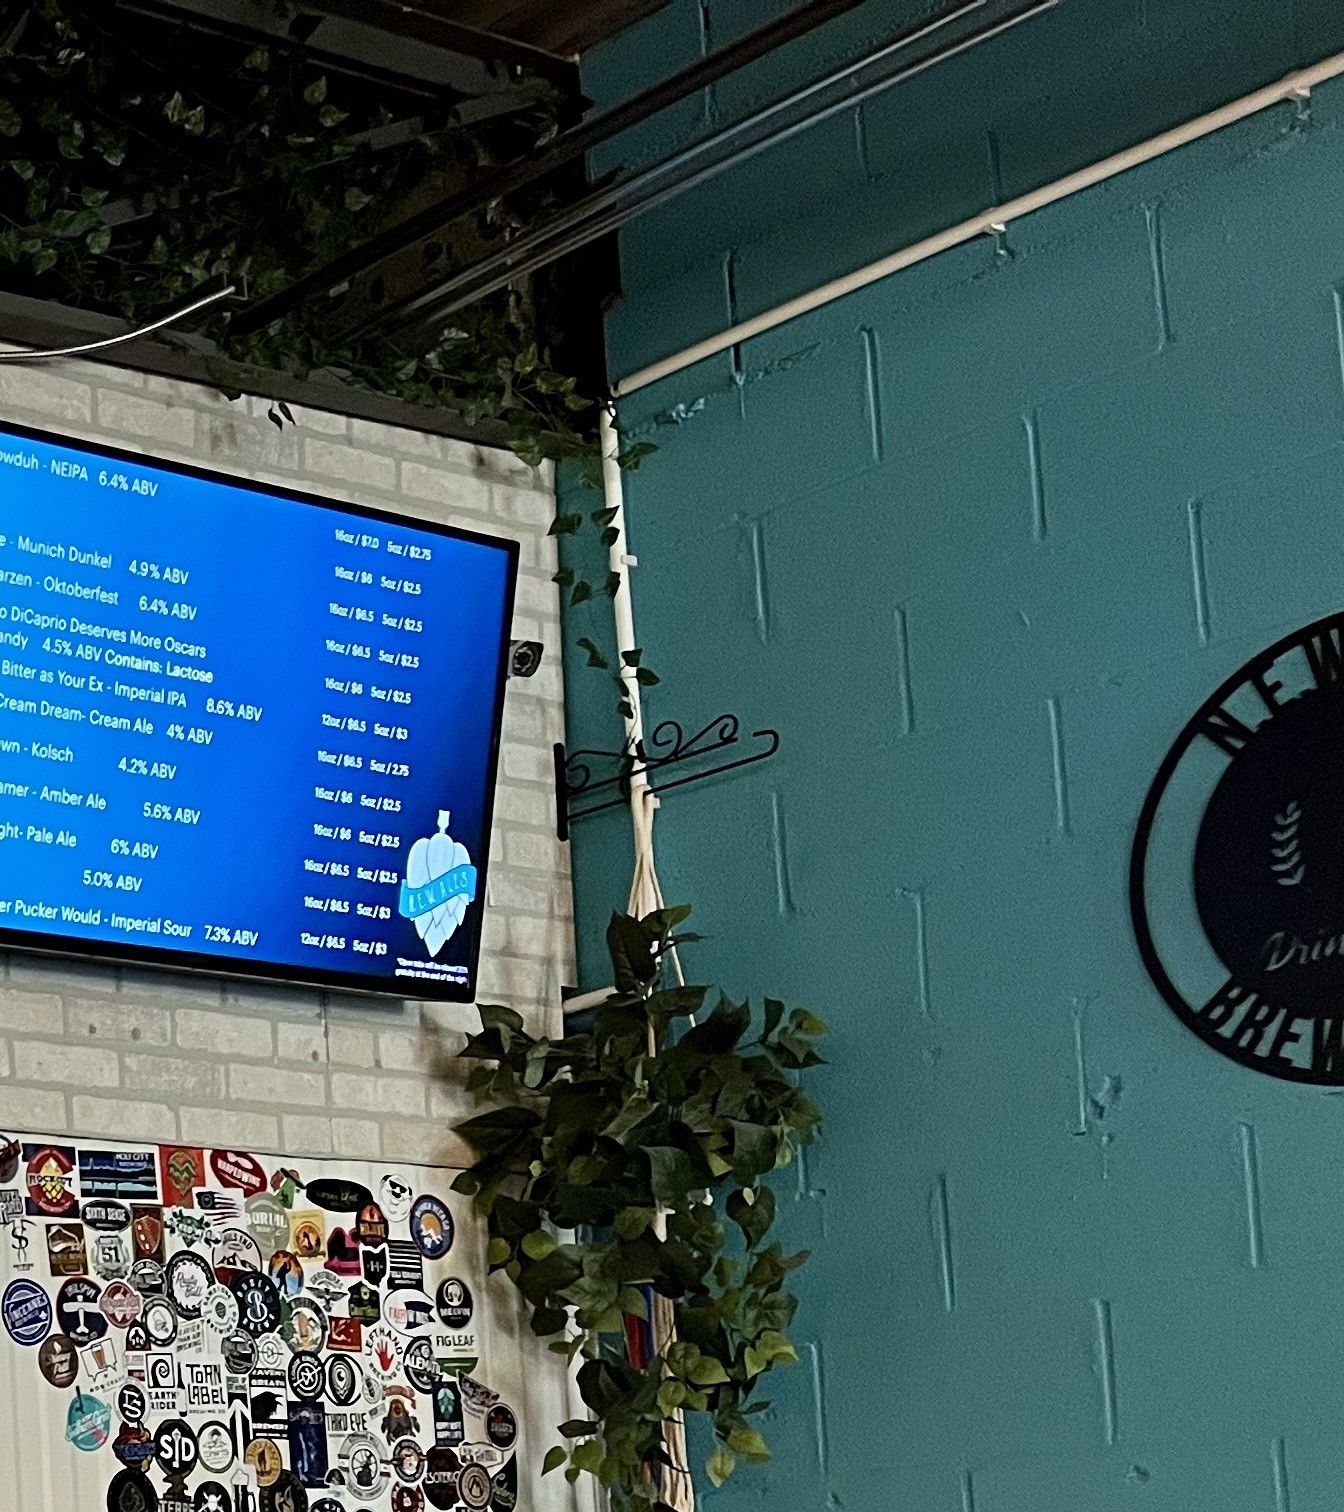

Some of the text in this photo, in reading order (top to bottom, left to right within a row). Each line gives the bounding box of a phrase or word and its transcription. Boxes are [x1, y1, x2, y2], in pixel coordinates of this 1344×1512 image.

[51, 460, 89, 481] NEIPA
[99, 471, 128, 490] 6.4%
[132, 478, 158, 497] ABV
[17, 536, 65, 559] Munich
[69, 546, 112, 569] Dunkel
[43, 576, 119, 605] Oktoberfest
[11, 604, 67, 630] DiCaprio
[70, 619, 127, 643] Deserves
[130, 630, 161, 650] More
[164, 637, 207, 658] Oscars
[1196, 622, 1344, 757] NEW
[89, 711, 130, 731] Cream
[133, 717, 154, 735] Ale
[31, 742, 73, 763] Kolsch
[26, 826, 53, 843] Pale
[56, 831, 77, 847] Ale
[15, 900, 58, 920] Pucker
[61, 905, 100, 925] Would
[245, 1212, 287, 1227] BURIAL
[440, 1307, 470, 1317] MELVIN
[436, 1335, 474, 1346] FIG LEAF
[149, 1391, 178, 1400] EARTH
[150, 1402, 176, 1410] RIDER
